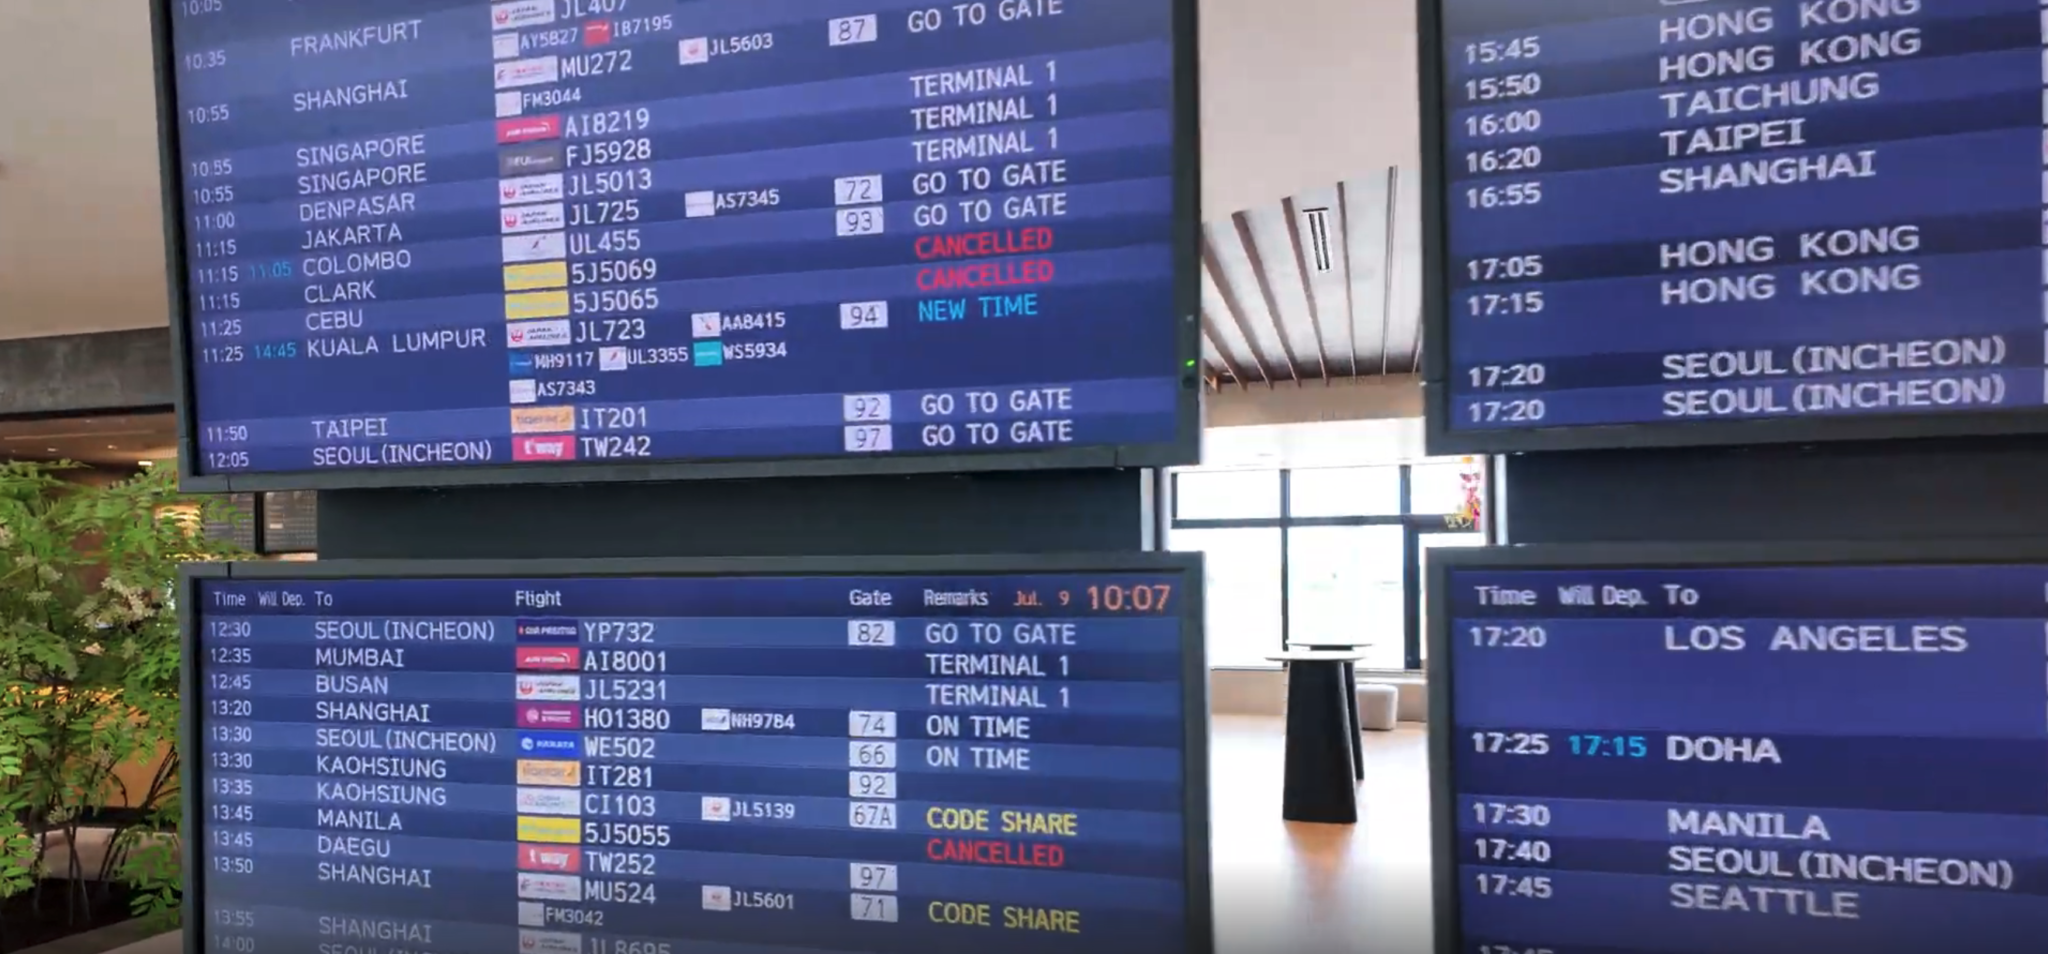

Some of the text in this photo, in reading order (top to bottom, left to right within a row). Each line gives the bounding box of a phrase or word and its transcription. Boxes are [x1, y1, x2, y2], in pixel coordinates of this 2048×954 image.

[291, 20, 421, 56] FRANKFURT
[520, 14, 672, 50] AY5827 IB7195
[1466, 36, 1540, 64] 15:45
[188, 104, 229, 124] 10:55
[294, 80, 408, 111] SHANGHAI
[562, 50, 632, 78] MU272
[710, 34, 773, 56] JL5603
[838, 20, 866, 41] 87
[1466, 28, 1920, 100] 15:50 HONG KONG
[297, 64, 1032, 166] SINGAPORE AI8219 TERMINAL
[524, 88, 581, 108] FM3044
[1466, 72, 1878, 136] 16:00 TAICHUNG
[194, 186, 233, 204] 10:55
[566, 138, 651, 166] FJ5928
[911, 96, 1034, 130] TERMINAL
[1467, 118, 1805, 172] 16:20 TAIPEI
[196, 211, 234, 229] 11:00
[300, 192, 414, 222] DENPASAR
[567, 168, 651, 196] JL5013
[1467, 150, 1876, 208] 16:55 SHANGHAI
[302, 223, 402, 249] JAKARTA
[568, 199, 639, 225] JL725
[716, 189, 780, 208] AS7345
[845, 180, 871, 200] 72
[913, 172, 946, 194] GO
[958, 168, 990, 190] TO
[1003, 160, 1066, 186] GATE
[198, 192, 1066, 283] 11:15 COLOMBO UL455 93 GO TO GATE
[1468, 226, 1918, 280] 17:05 HONG KONG
[305, 280, 376, 303] CLARK
[572, 258, 656, 284] 5J5069
[916, 228, 1052, 258] CANCELLED
[202, 319, 241, 336] 11:25
[306, 310, 362, 330] CEBU
[574, 288, 658, 313] 5J5065
[918, 260, 1052, 290] CANCELLED
[1468, 292, 1543, 315] 17:15
[204, 346, 243, 362] 11:25
[256, 342, 296, 358] 14:45
[308, 336, 378, 357] KUALA
[393, 328, 486, 352] LUMPUR
[574, 318, 645, 342] JL723
[722, 311, 786, 331] AA8415
[850, 305, 878, 326] 94
[919, 298, 966, 321] NEW
[978, 294, 1038, 317] TIME
[534, 342, 787, 369] MH9117 UL3355 WS5934
[1470, 364, 1544, 386] 17:20
[538, 380, 595, 396] AS7343
[208, 426, 248, 442] 11:50
[312, 418, 388, 438] TAIPEI
[578, 406, 646, 430] IT201
[854, 398, 881, 418] 92
[922, 394, 954, 416] GO
[966, 392, 998, 414] TO
[1010, 388, 1072, 412] GATE
[210, 452, 248, 468] 12:05
[580, 436, 650, 457] TW242
[855, 428, 881, 447] 97
[214, 585, 1171, 612] Time Dep. To Flight Gate Remarks Jul. 10:07
[1474, 584, 1698, 609] Time Will Dep. To
[212, 622, 250, 637] 12:30
[584, 622, 654, 642] YP732
[857, 623, 885, 643] 82
[926, 622, 958, 644] GO
[970, 623, 1002, 644] TO
[1014, 624, 1076, 644] GATE
[1470, 626, 1968, 652] 17:20 LOS ANGELES
[212, 648, 1046, 676] 12:35 MUMBAI AI8001 TERMINAL
[212, 674, 250, 690] 12:45
[316, 675, 388, 694] BUSAN
[583, 680, 666, 700] JL5231
[926, 684, 1046, 708] TERMINAL
[212, 700, 1030, 738] 13:20 SHANGHAI NH9784 74 ON TIME
[212, 726, 1030, 770] 13:30 WE502 66 ON TIME
[1472, 732, 1781, 763] 17:25 17:15 DOHA
[318, 755, 446, 778] KAOHSIUNG
[588, 765, 652, 787] IT281
[859, 775, 886, 795] 92
[214, 778, 252, 794] 13:35
[585, 794, 656, 816] CI103
[732, 801, 795, 820] JL5139
[854, 805, 892, 826] 67A
[928, 808, 988, 830] CODE
[1002, 811, 1077, 835] SHARE
[1474, 803, 1830, 840] 17:30 MANILA
[214, 804, 252, 821] 13:45
[318, 809, 402, 830] MANILA
[586, 822, 670, 846] 5J5055
[928, 839, 1064, 866] CANCELLED
[1476, 838, 1550, 862] 17:40
[318, 836, 886, 886] DAEGU TW252 97
[214, 857, 253, 873] 13:50
[318, 862, 430, 888] SHANGHAI
[586, 880, 656, 904] MU524
[733, 890, 795, 910] JL5601
[861, 899, 885, 919] 71
[929, 902, 990, 925] CODE
[1004, 906, 1078, 932] SHARE
[1478, 874, 1858, 918] 17:45 SEATTLE
[546, 907, 604, 926] FM3042
